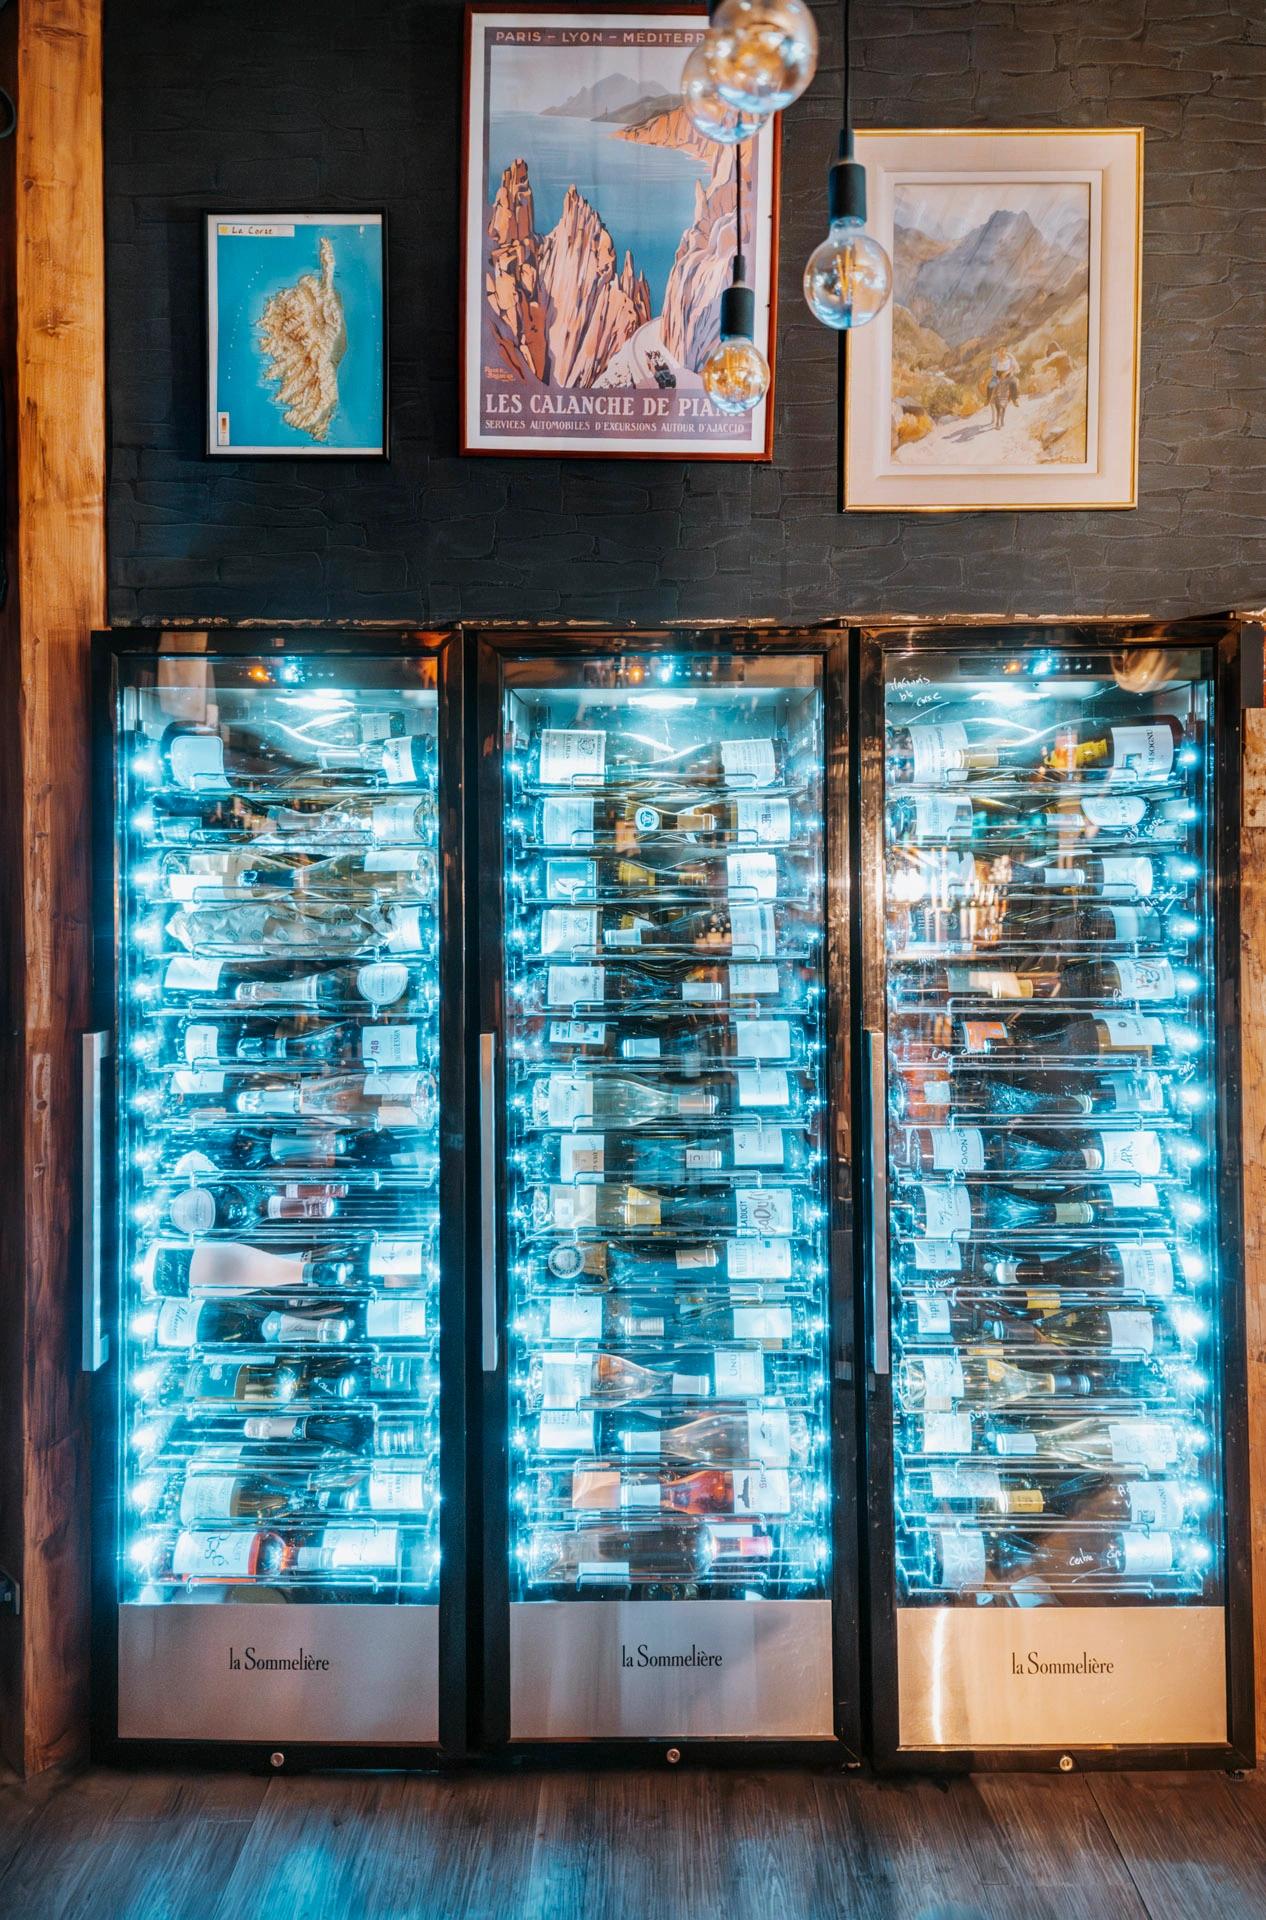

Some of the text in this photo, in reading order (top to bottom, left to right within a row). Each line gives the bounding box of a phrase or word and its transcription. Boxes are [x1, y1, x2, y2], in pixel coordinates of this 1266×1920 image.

[496, 31, 541, 42] PARIS
[562, 31, 603, 43] LYON
[623, 32, 705, 43] MEDITERR
[485, 393, 746, 417] LES CALANCHE DE PIA
[485, 419, 745, 433] SERVICES AUTOMOBILES D'EXCURSIONS AUTOUR D'AJACCIO
[229, 1646, 330, 1671] la Sommelière
[622, 1643, 723, 1668] la Sommelière
[1012, 1651, 1114, 1675] la Sommelière
